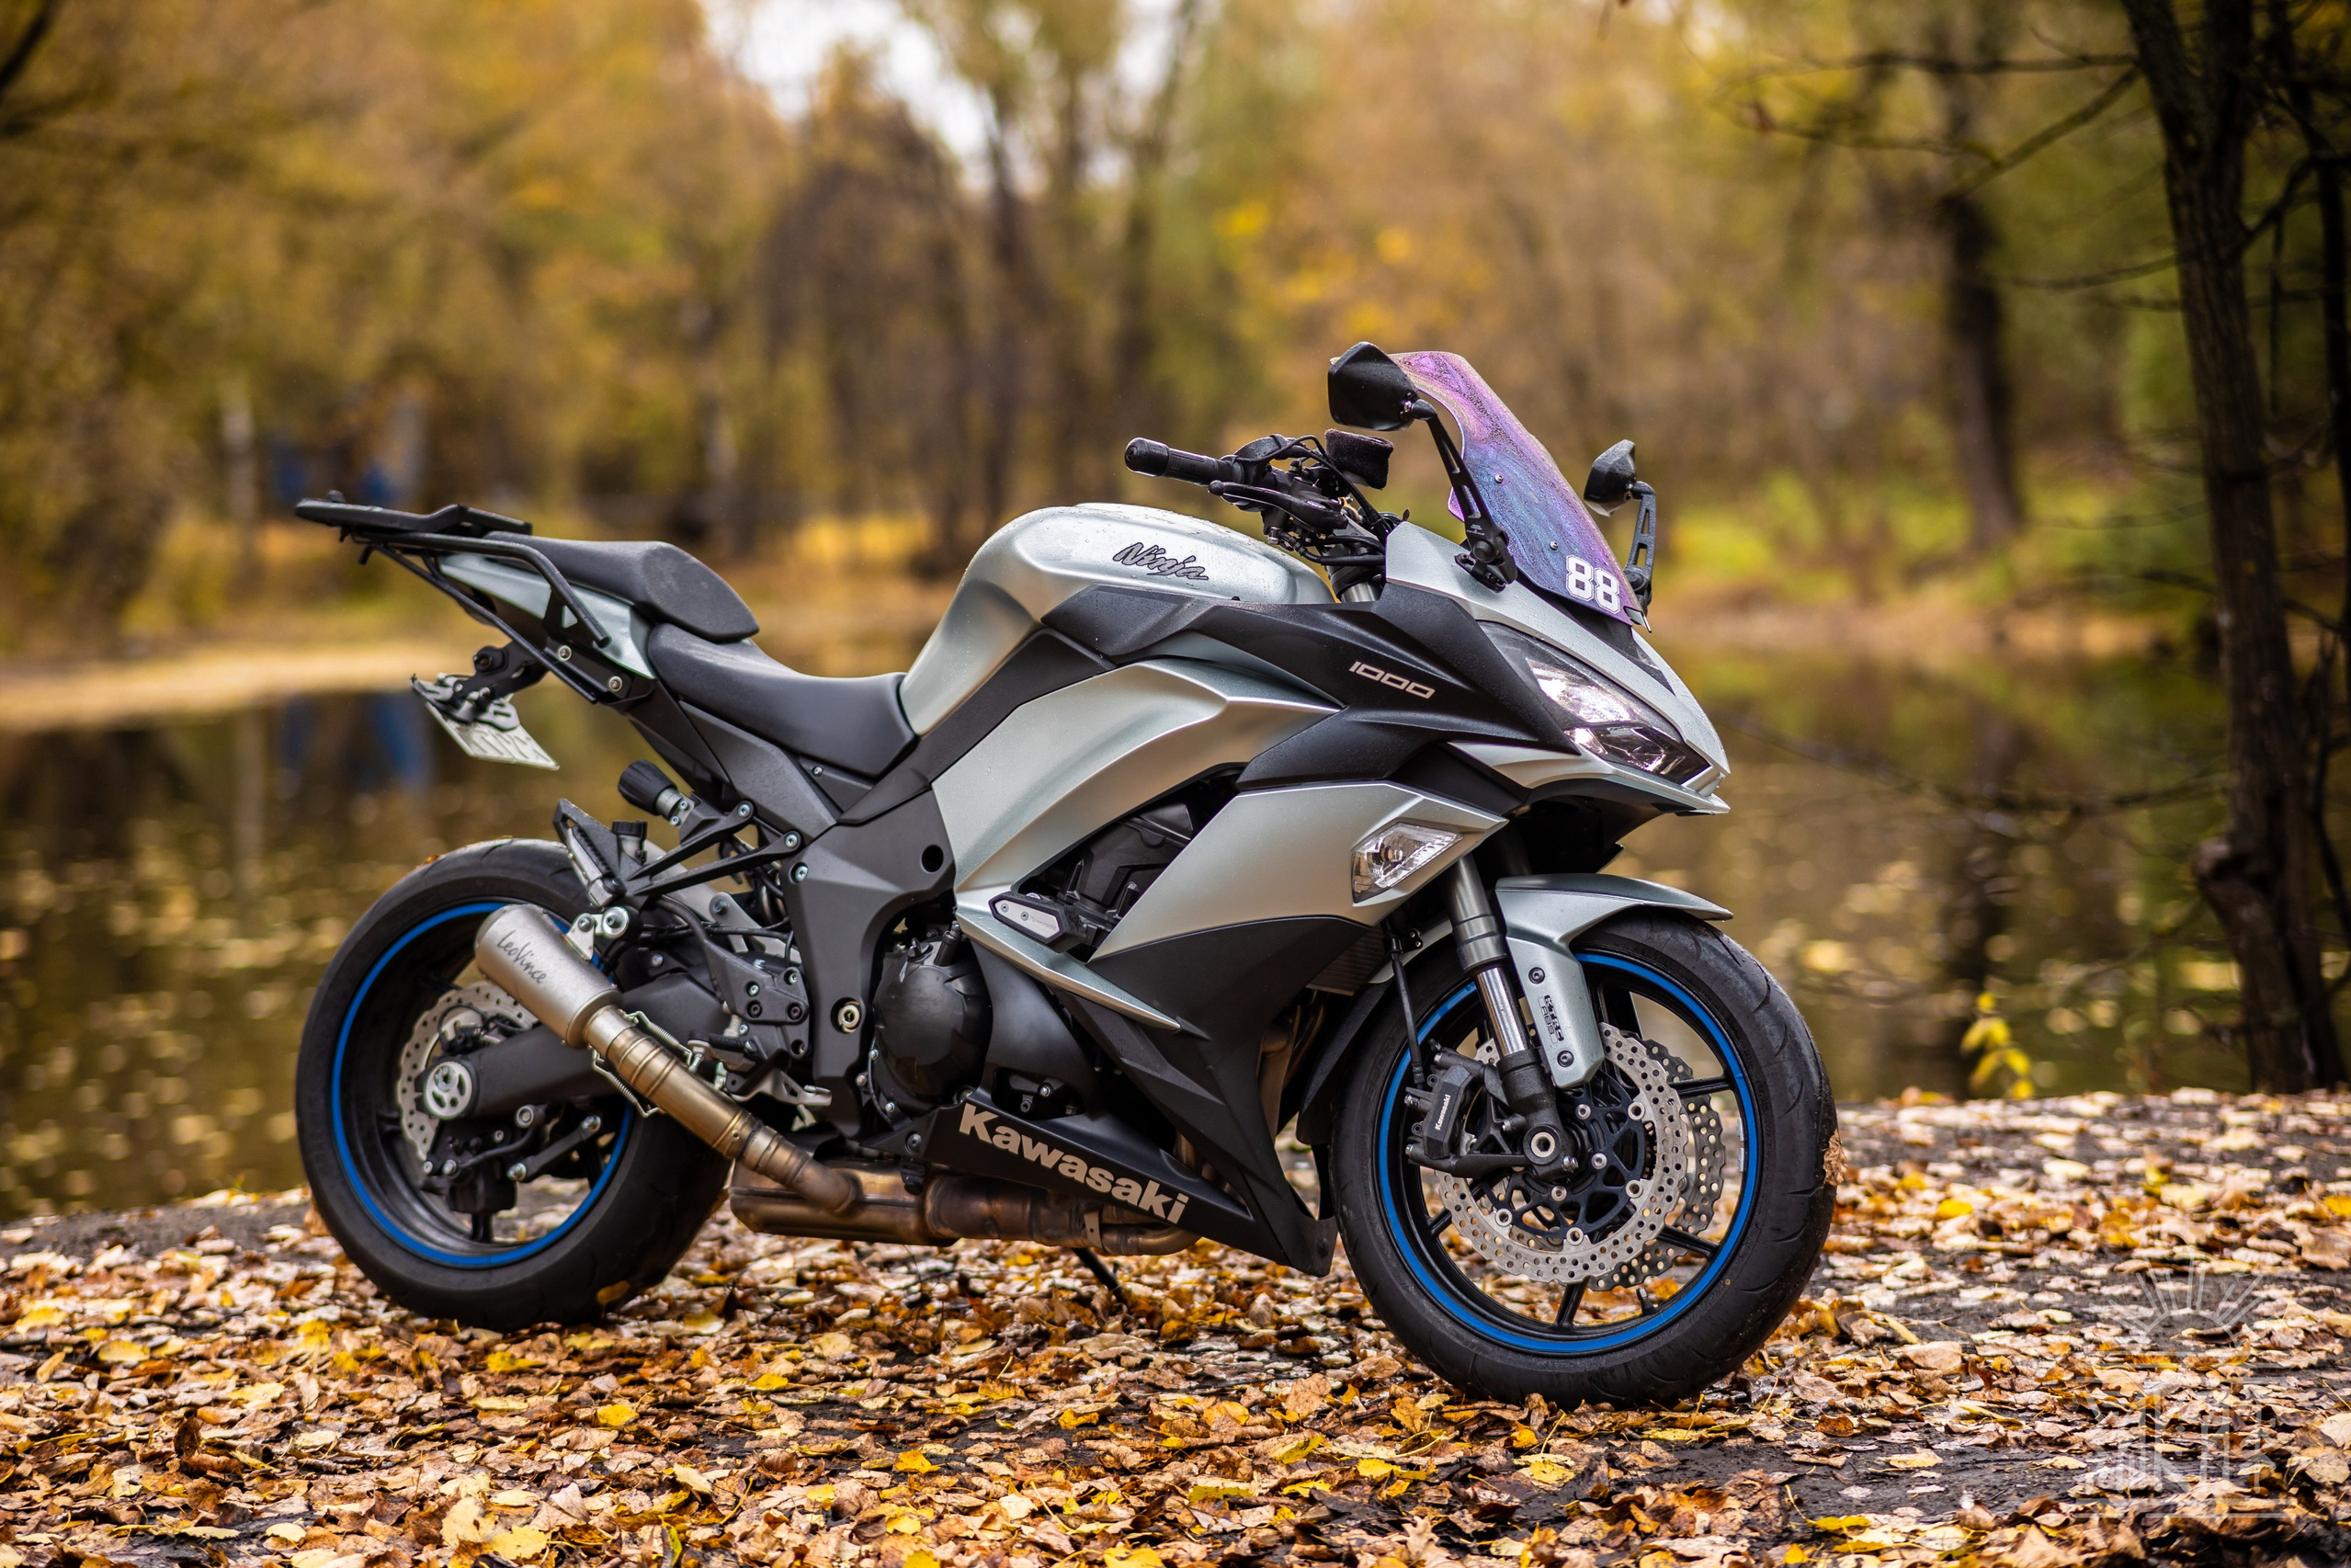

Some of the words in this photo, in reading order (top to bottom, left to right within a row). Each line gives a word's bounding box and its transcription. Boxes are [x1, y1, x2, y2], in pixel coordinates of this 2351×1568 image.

[1112, 541, 1210, 580] Ninja
[1565, 554, 1620, 614] 88
[1348, 661, 1436, 699] 1000
[496, 929, 547, 983] LeoVince
[1541, 1006, 1555, 1035] ABS
[1435, 1094, 1451, 1131] Kawasaki
[960, 1103, 1189, 1224] Kawasaki
